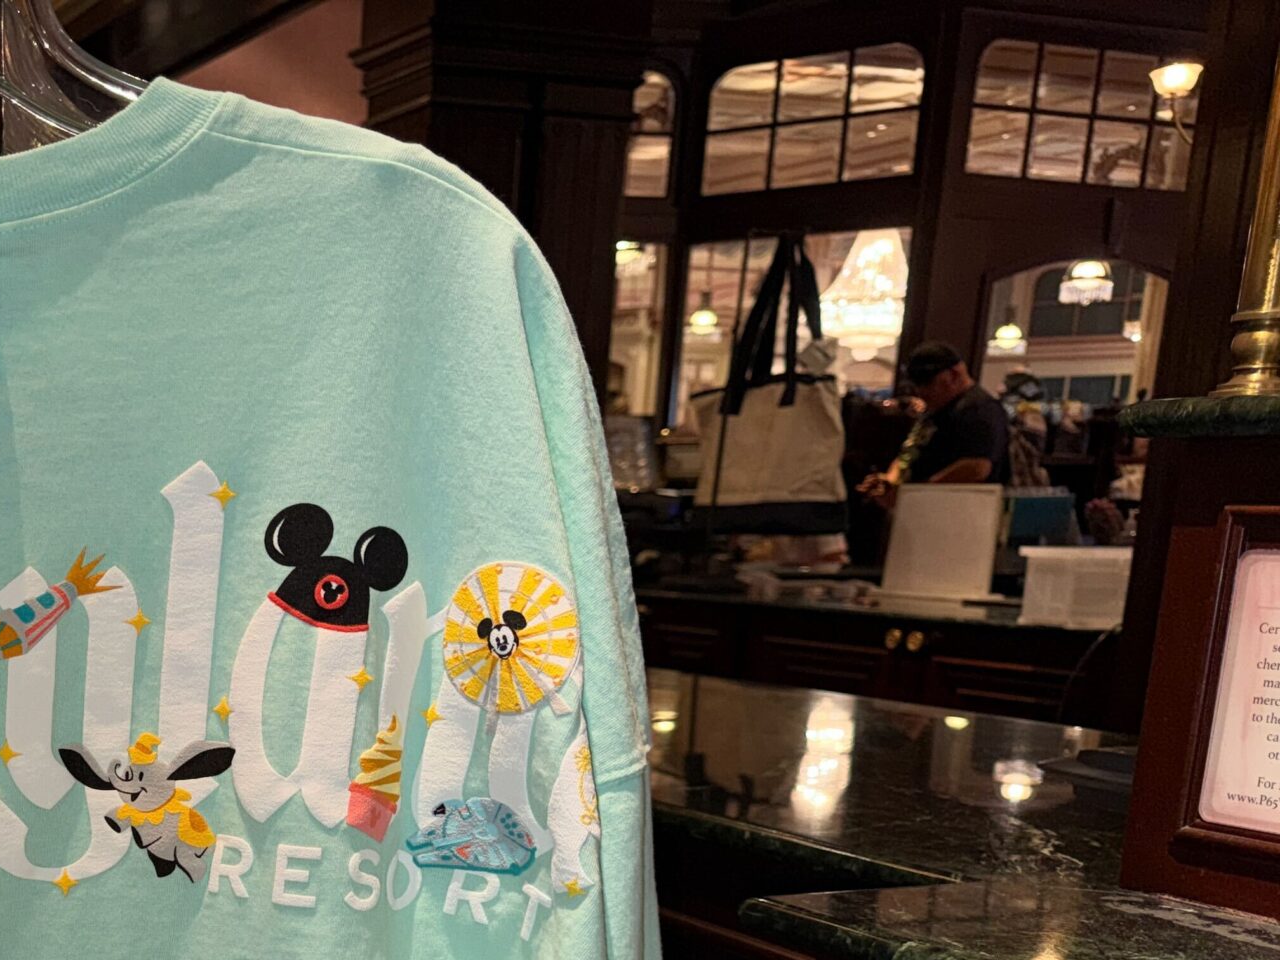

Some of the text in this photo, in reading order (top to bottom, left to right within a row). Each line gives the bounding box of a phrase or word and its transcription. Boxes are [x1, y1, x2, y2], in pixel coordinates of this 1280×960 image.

[1251, 713, 1263, 723] to
[1256, 776, 1277, 790] For
[1226, 791, 1280, 810] www.P65
[206, 834, 553, 941] RESORT
